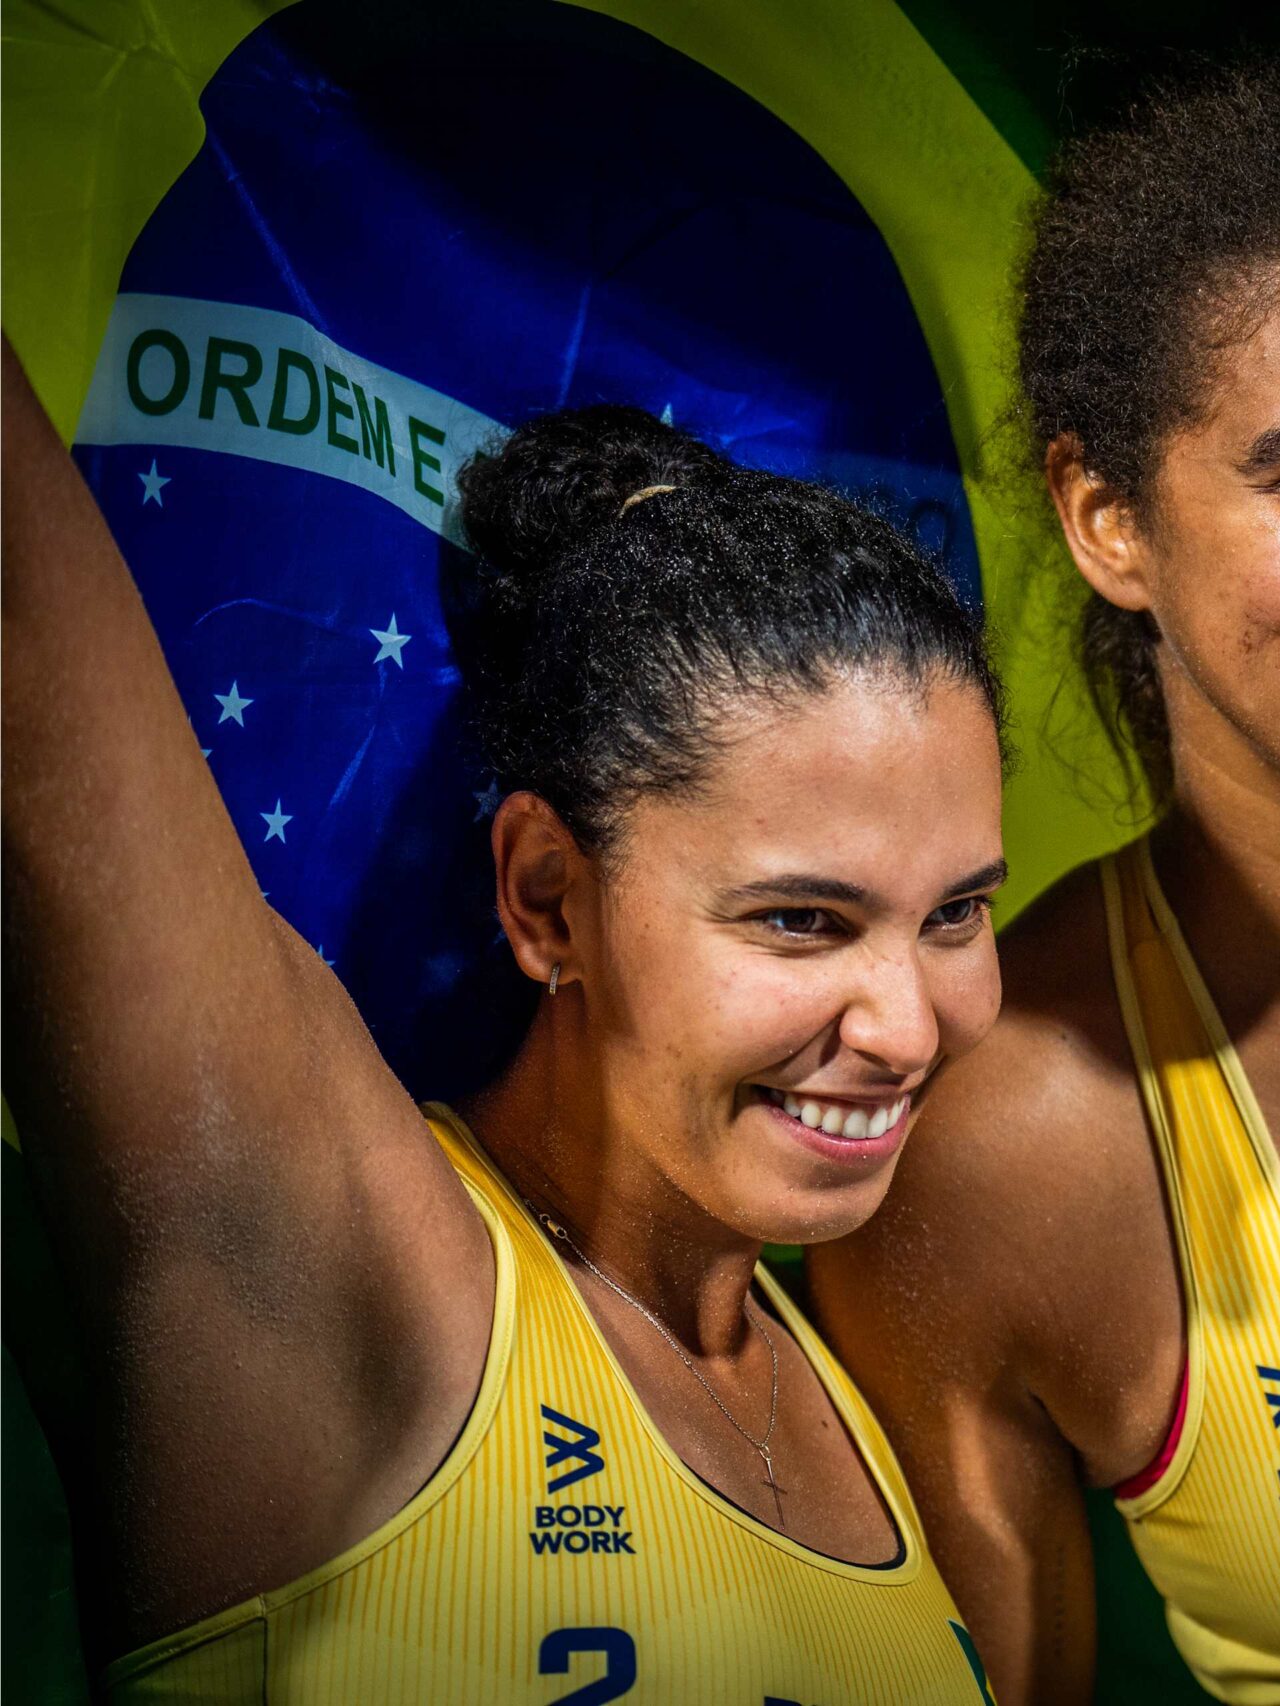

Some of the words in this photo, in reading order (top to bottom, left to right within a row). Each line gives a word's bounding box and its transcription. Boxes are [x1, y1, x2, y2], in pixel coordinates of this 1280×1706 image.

[126, 329, 396, 477] ORDEM
[409, 416, 446, 507] E
[530, 1530, 636, 1555] WORK
[536, 1505, 626, 1528] BODY
[538, 1626, 637, 1706] 2
